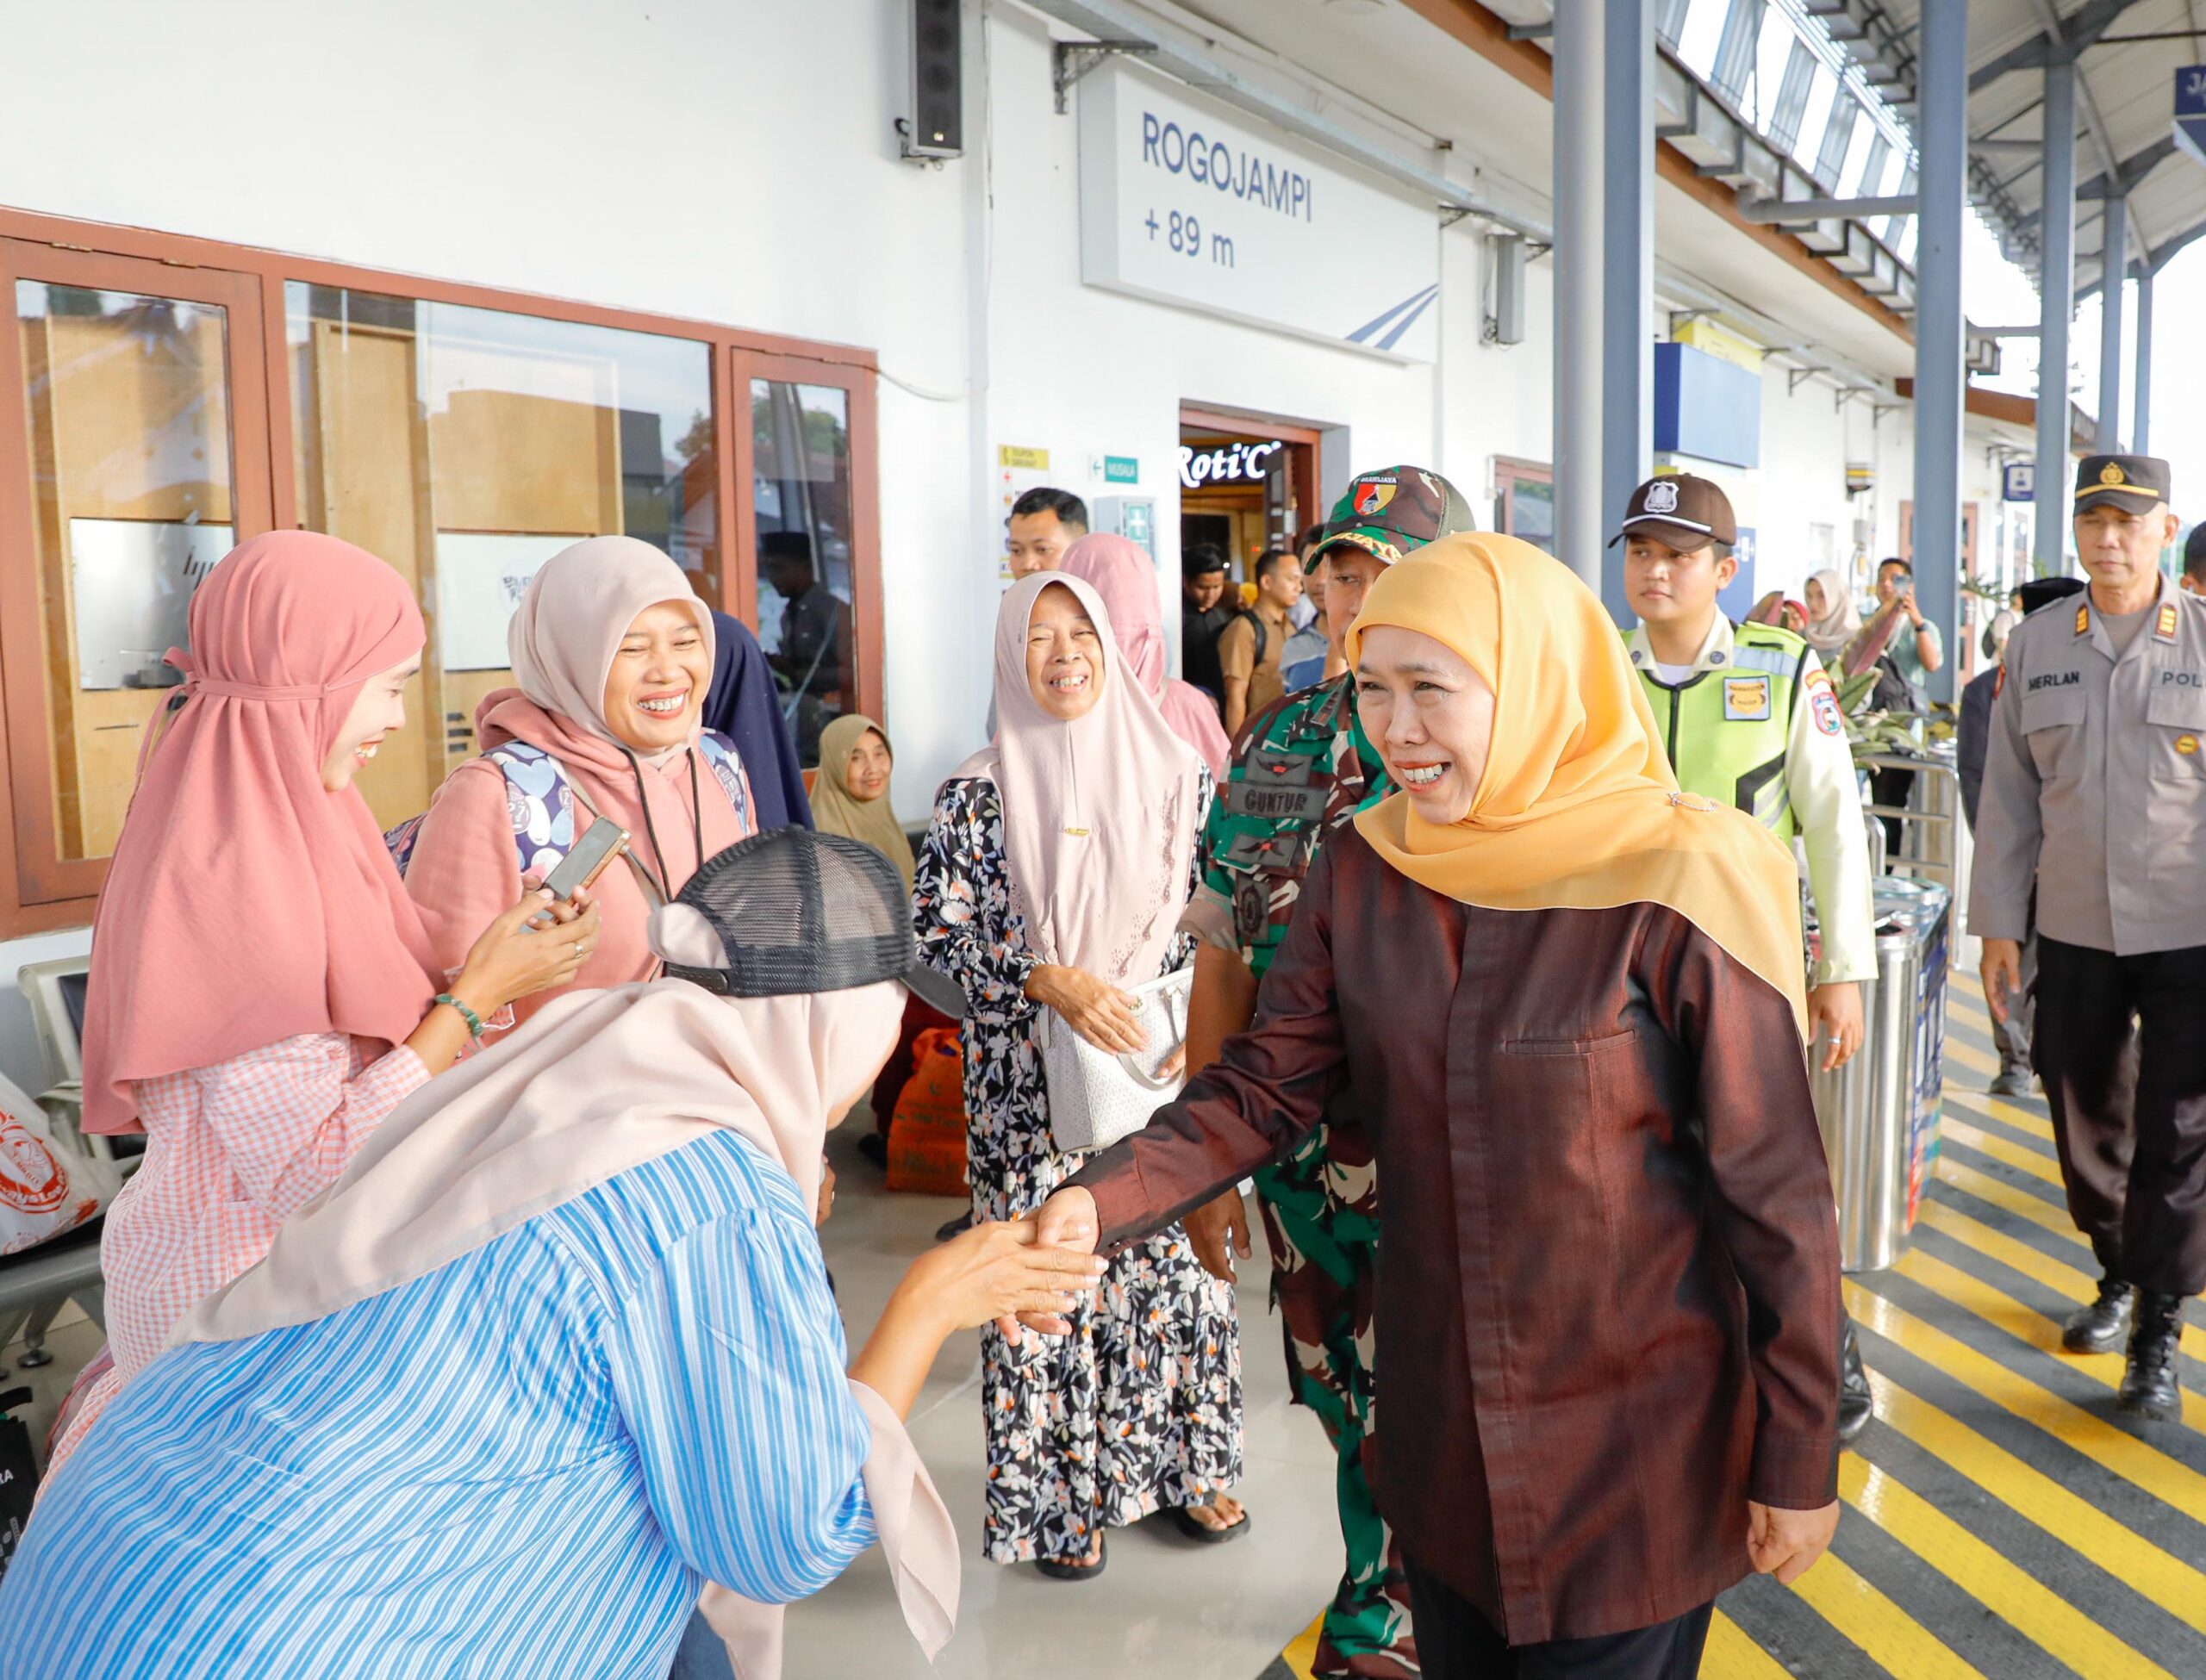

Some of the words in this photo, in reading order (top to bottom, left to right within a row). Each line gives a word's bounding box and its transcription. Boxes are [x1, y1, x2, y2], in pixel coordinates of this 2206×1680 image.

[1144, 111, 1311, 223] ROGOJAMPI
[1169, 209, 1200, 257] 89
[1212, 233, 1234, 268] m
[1245, 788, 1308, 812] GUNTUR
